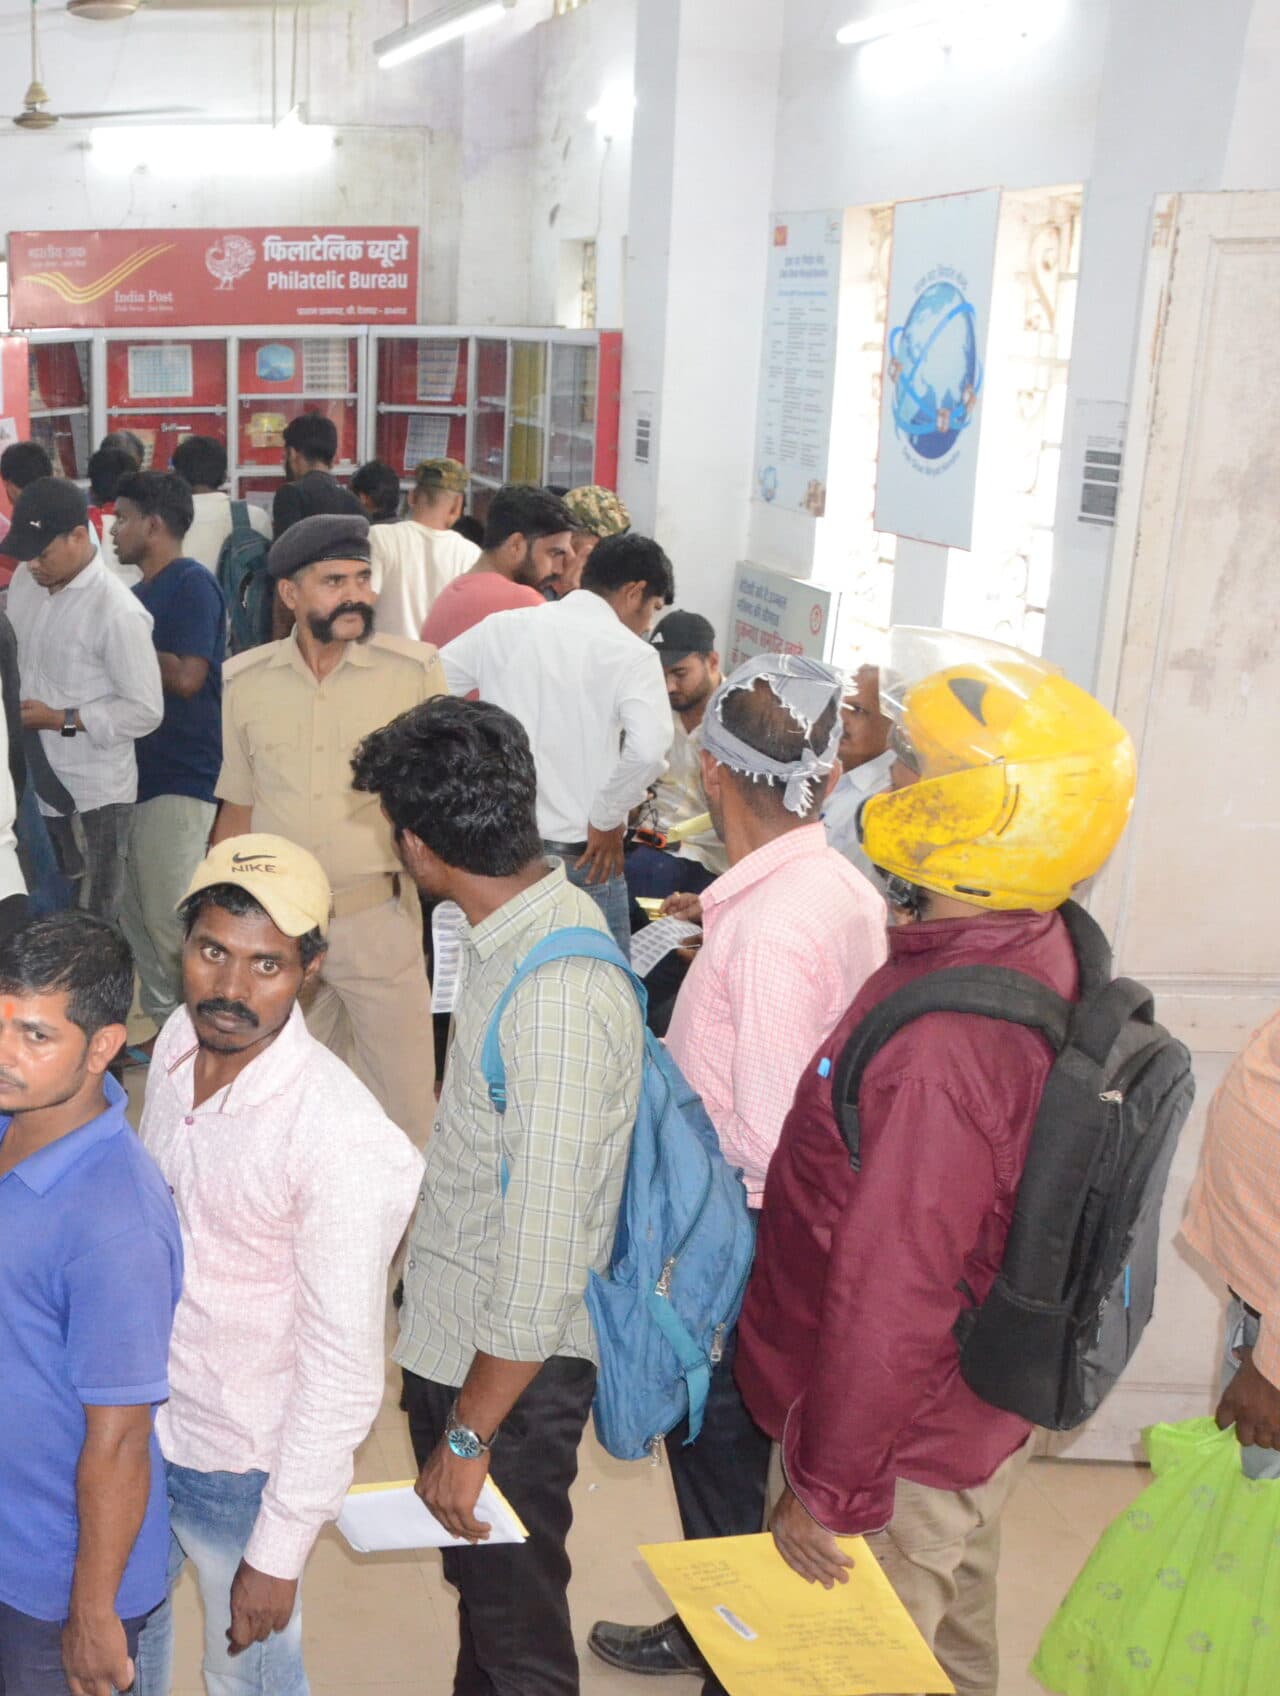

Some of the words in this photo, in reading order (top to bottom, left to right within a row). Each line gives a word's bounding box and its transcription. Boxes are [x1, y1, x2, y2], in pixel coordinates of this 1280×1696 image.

[262, 234, 364, 262] फिलाटेलिक
[366, 233, 409, 268] ब्यूरो
[267, 270, 345, 290] Philatelic
[348, 271, 409, 290] Bureau
[114, 290, 145, 304] India
[148, 290, 174, 303] Post
[231, 864, 276, 873] NIKE
